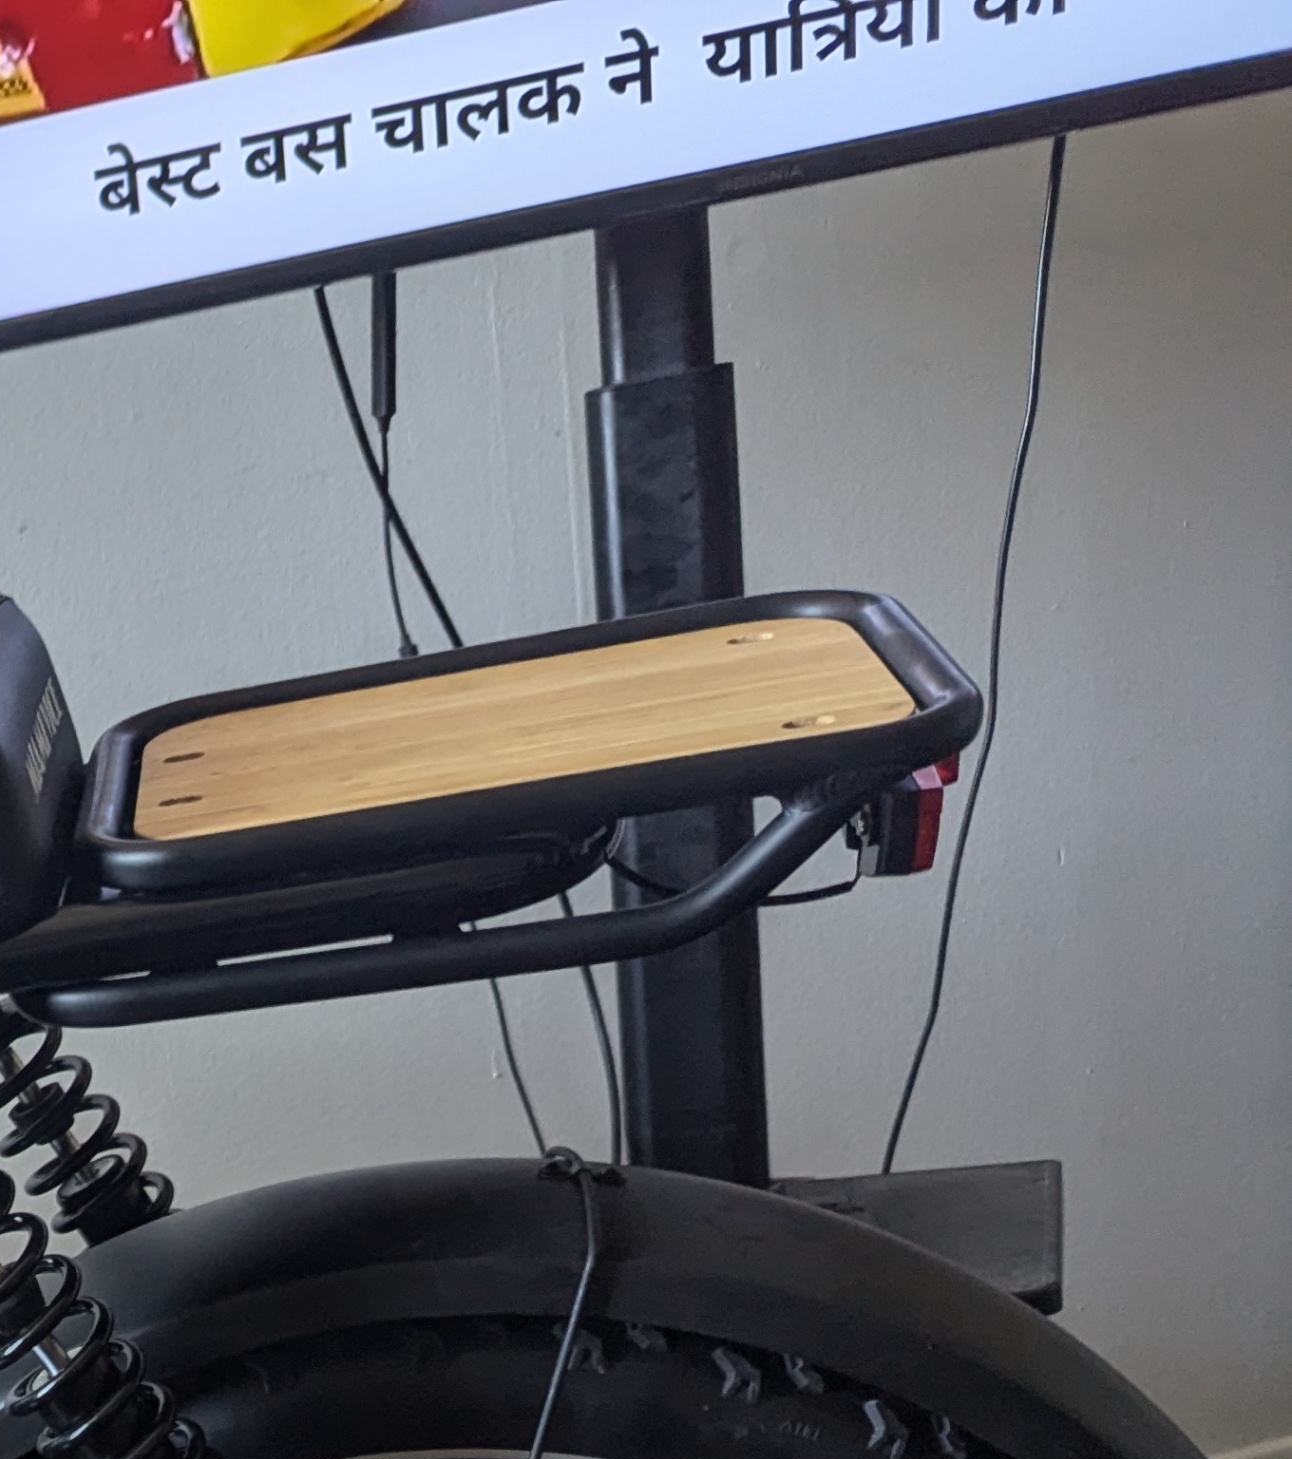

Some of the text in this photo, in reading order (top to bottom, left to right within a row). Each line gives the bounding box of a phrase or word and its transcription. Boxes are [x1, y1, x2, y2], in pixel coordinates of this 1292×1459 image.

[93, 142, 221, 216] बेस्ट
[240, 113, 352, 184] बस
[371, 62, 584, 154] चालक
[604, 28, 659, 105] ने
